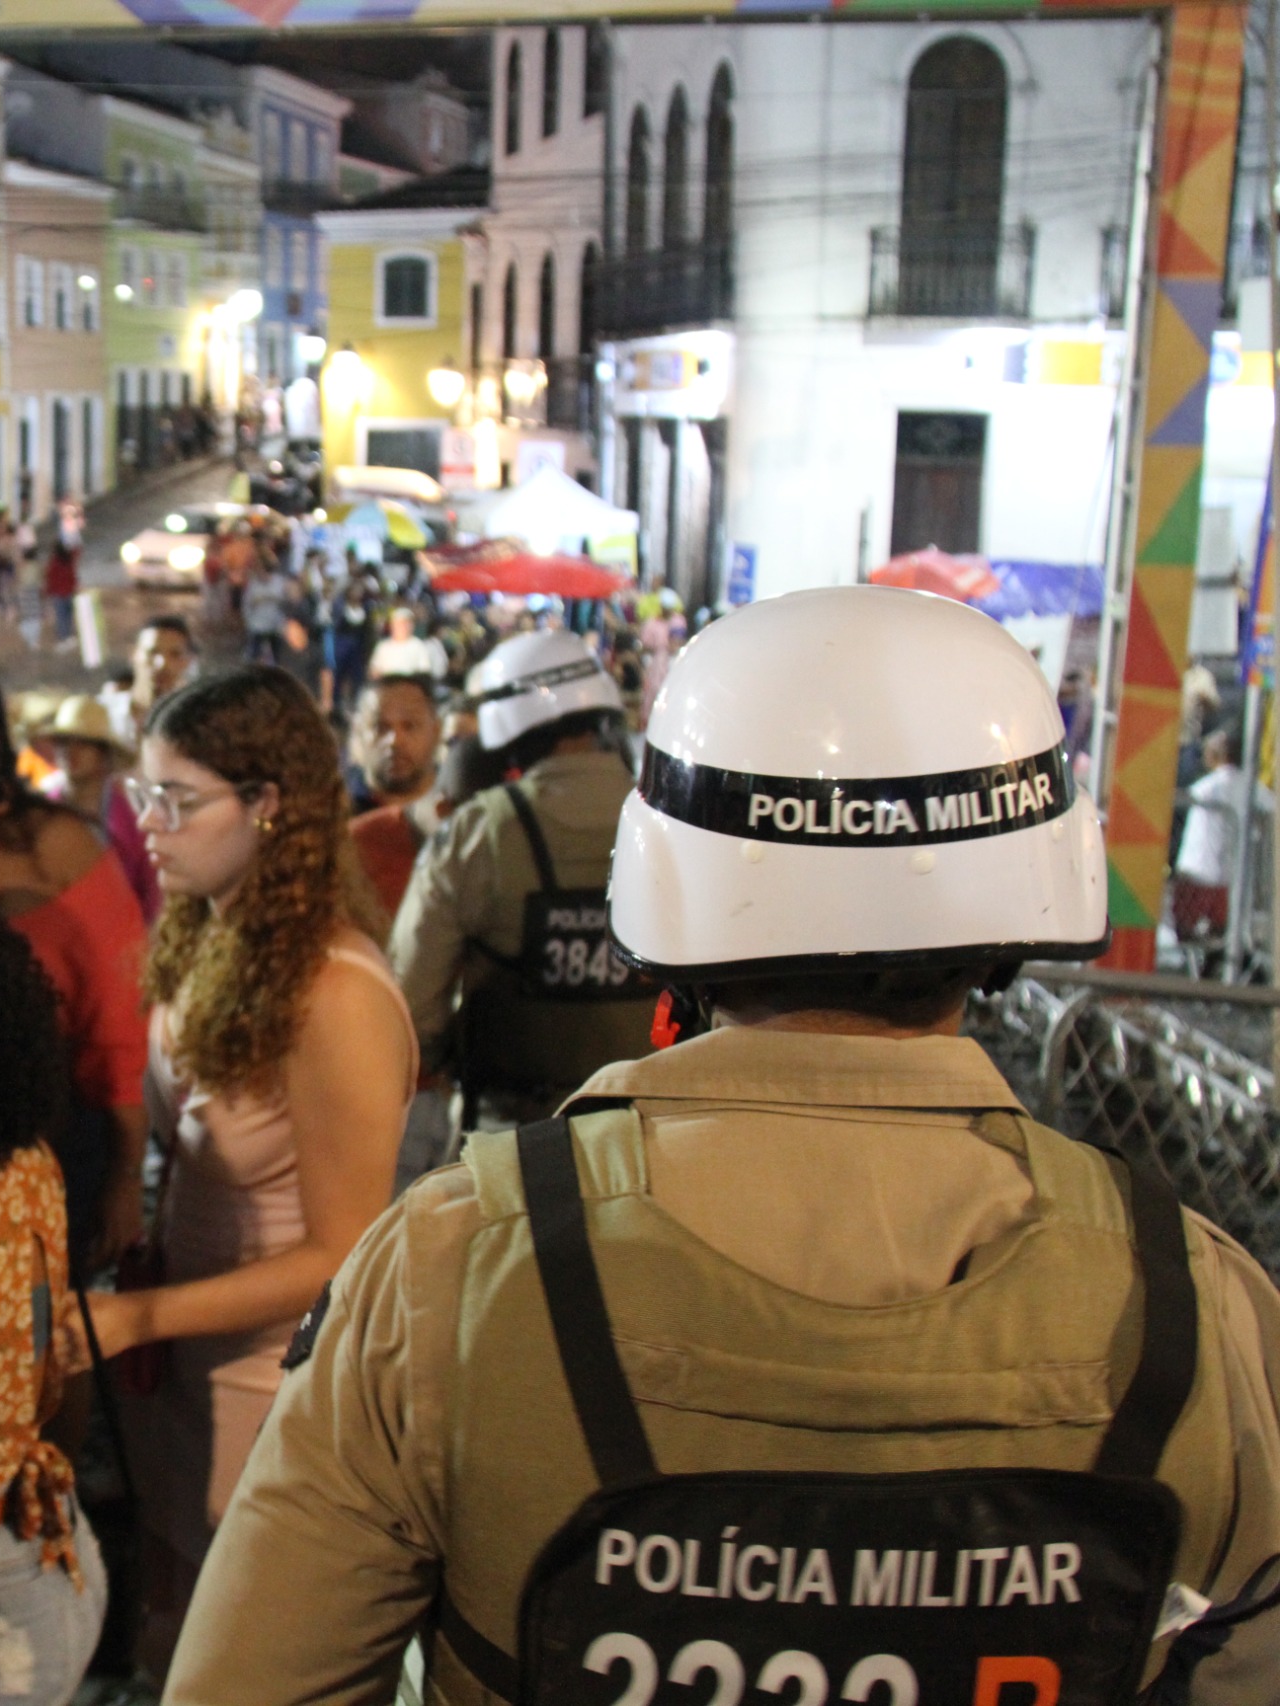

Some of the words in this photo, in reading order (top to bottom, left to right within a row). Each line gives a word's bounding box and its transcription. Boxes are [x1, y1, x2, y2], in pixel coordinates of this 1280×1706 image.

[747, 788, 918, 835] POLÍCIA
[926, 772, 1055, 832] MILITAR
[595, 1526, 838, 1606] POLÍCIA
[850, 1541, 1083, 1608] MILITAR
